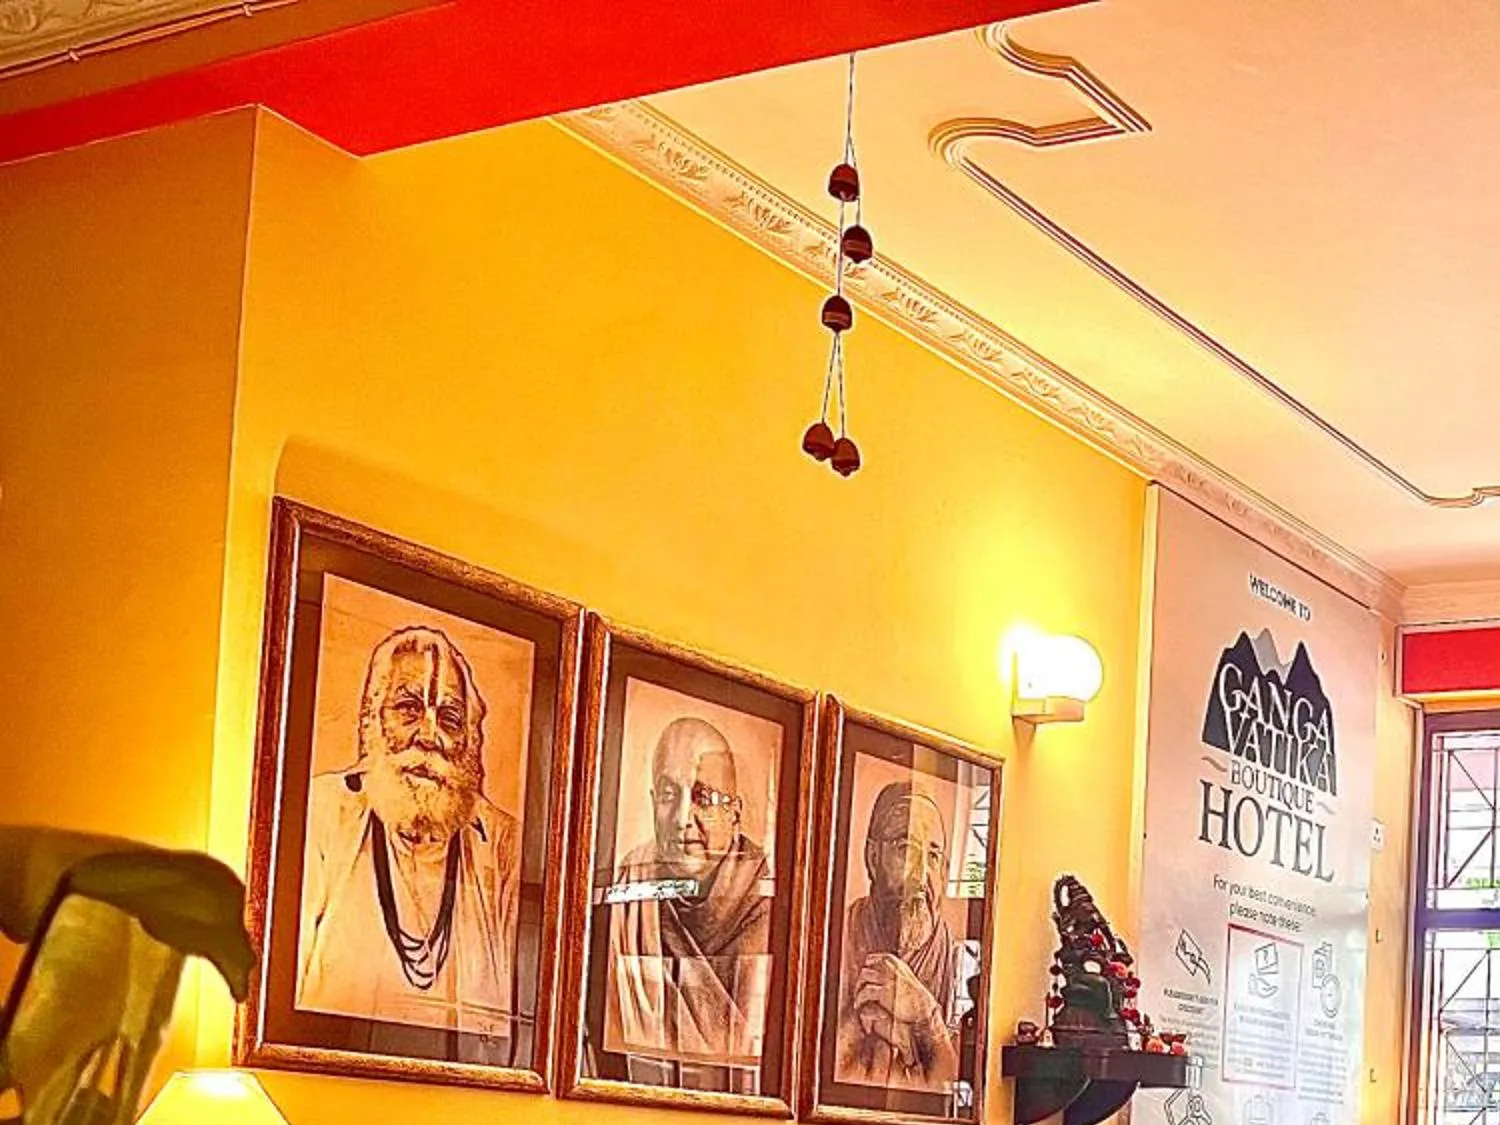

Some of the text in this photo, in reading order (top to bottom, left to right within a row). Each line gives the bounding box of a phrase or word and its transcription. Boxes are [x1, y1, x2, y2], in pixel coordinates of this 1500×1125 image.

[1249, 573, 1311, 622] WELCOME TO
[1219, 662, 1332, 755] GANGA
[1225, 708, 1337, 797] VATIKA
[1231, 759, 1314, 813] BOUTIQUE
[1199, 778, 1335, 882] HOTEL
[1213, 873, 1228, 891] For
[1229, 883, 1247, 896] your
[1248, 886, 1267, 903] best
[1229, 900, 1259, 921] please
[1260, 910, 1277, 926] note
